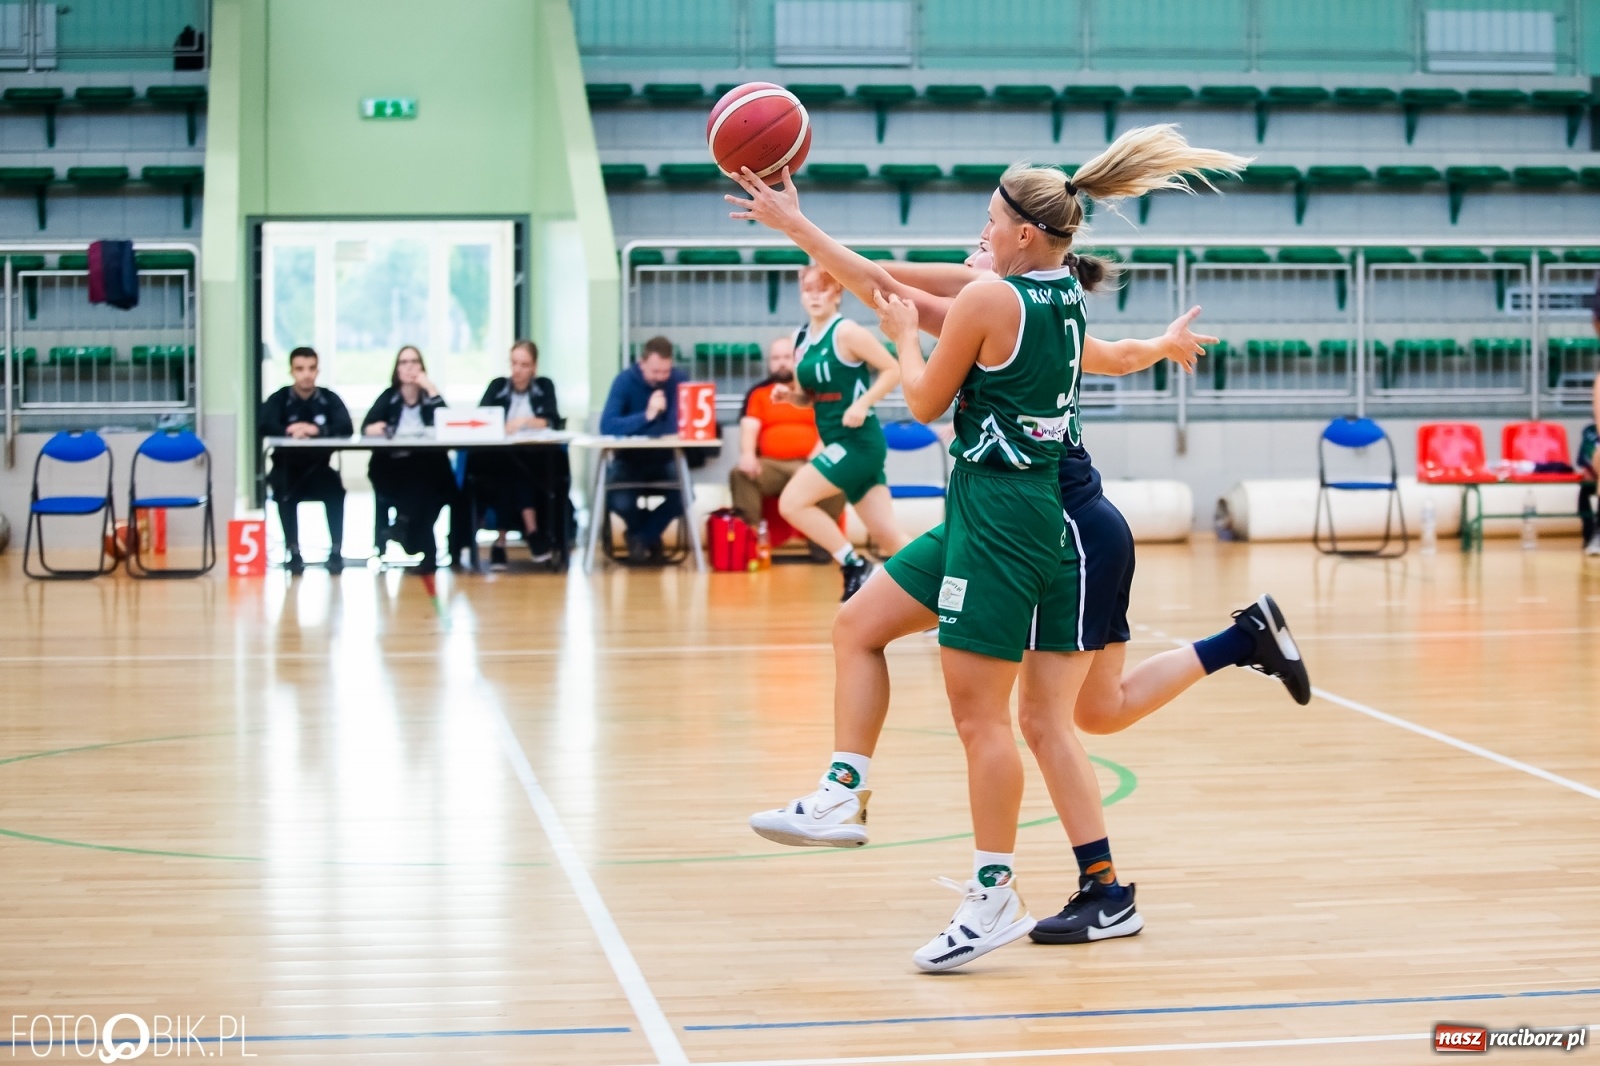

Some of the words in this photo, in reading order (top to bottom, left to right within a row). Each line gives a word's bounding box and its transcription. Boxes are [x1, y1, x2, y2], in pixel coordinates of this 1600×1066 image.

[815, 361, 831, 383] 11
[1056, 317, 1081, 409] 3
[692, 388, 713, 428] 5
[233, 523, 261, 564] 5
